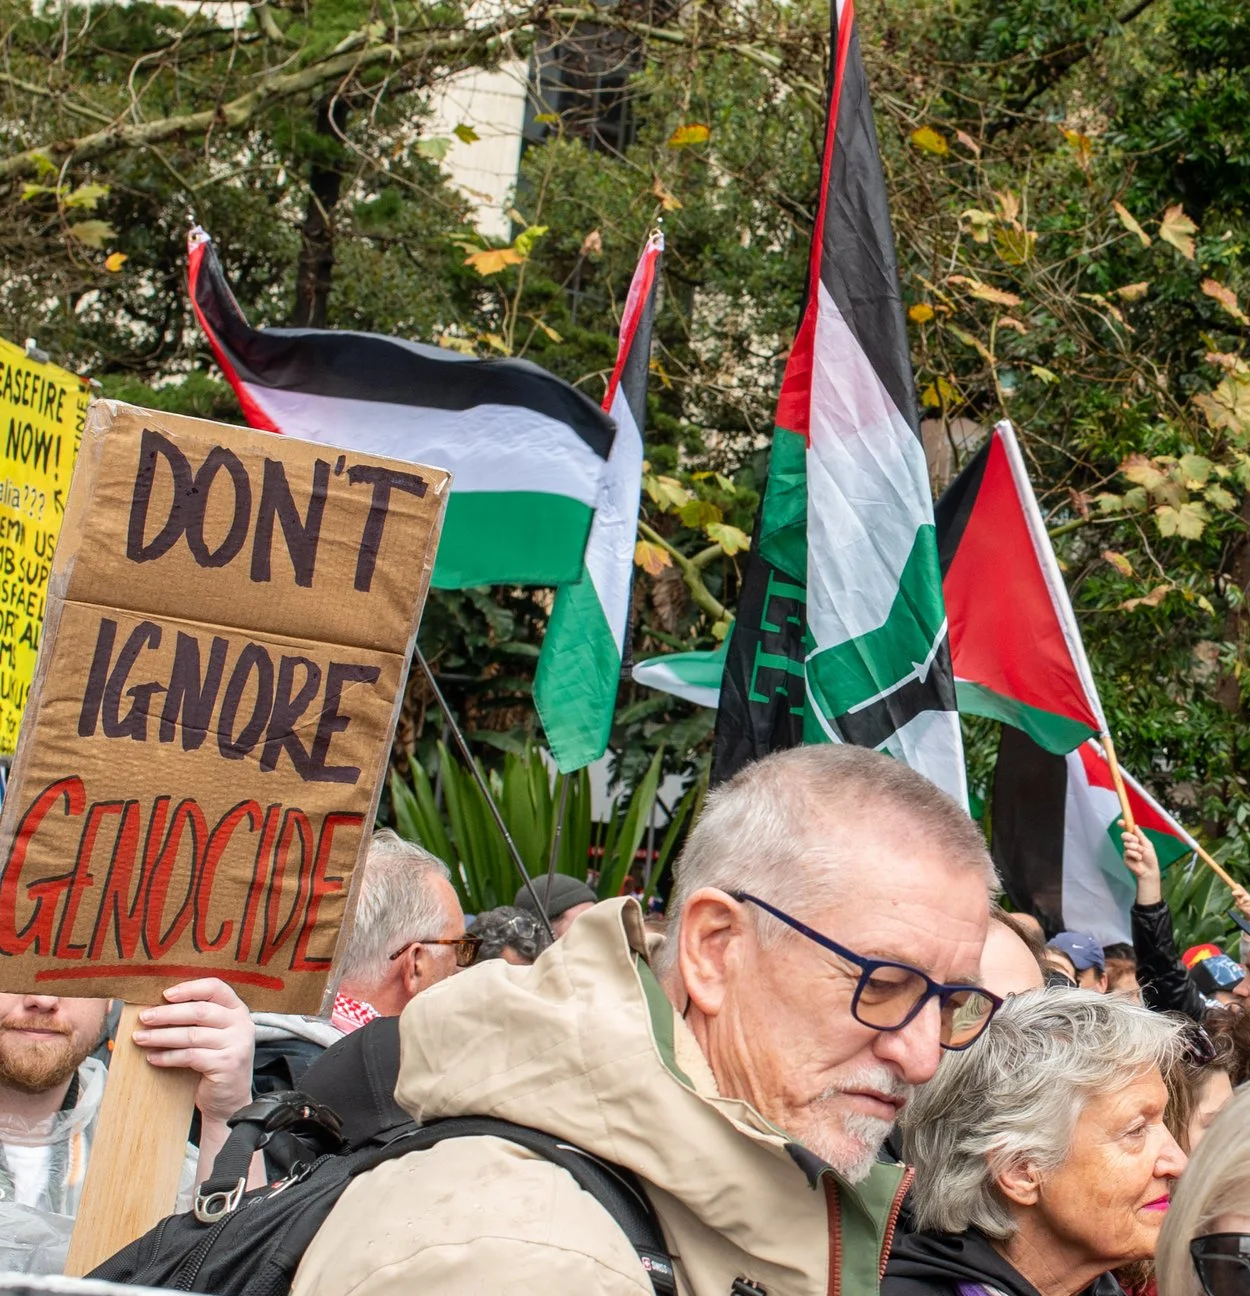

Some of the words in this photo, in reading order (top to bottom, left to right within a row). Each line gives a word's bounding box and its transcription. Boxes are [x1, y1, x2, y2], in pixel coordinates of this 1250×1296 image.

[6, 417, 62, 483] NOW!
[126, 428, 428, 592] DON'T
[78, 618, 381, 784] IGNORE
[0, 775, 366, 971] GENOCIDE
